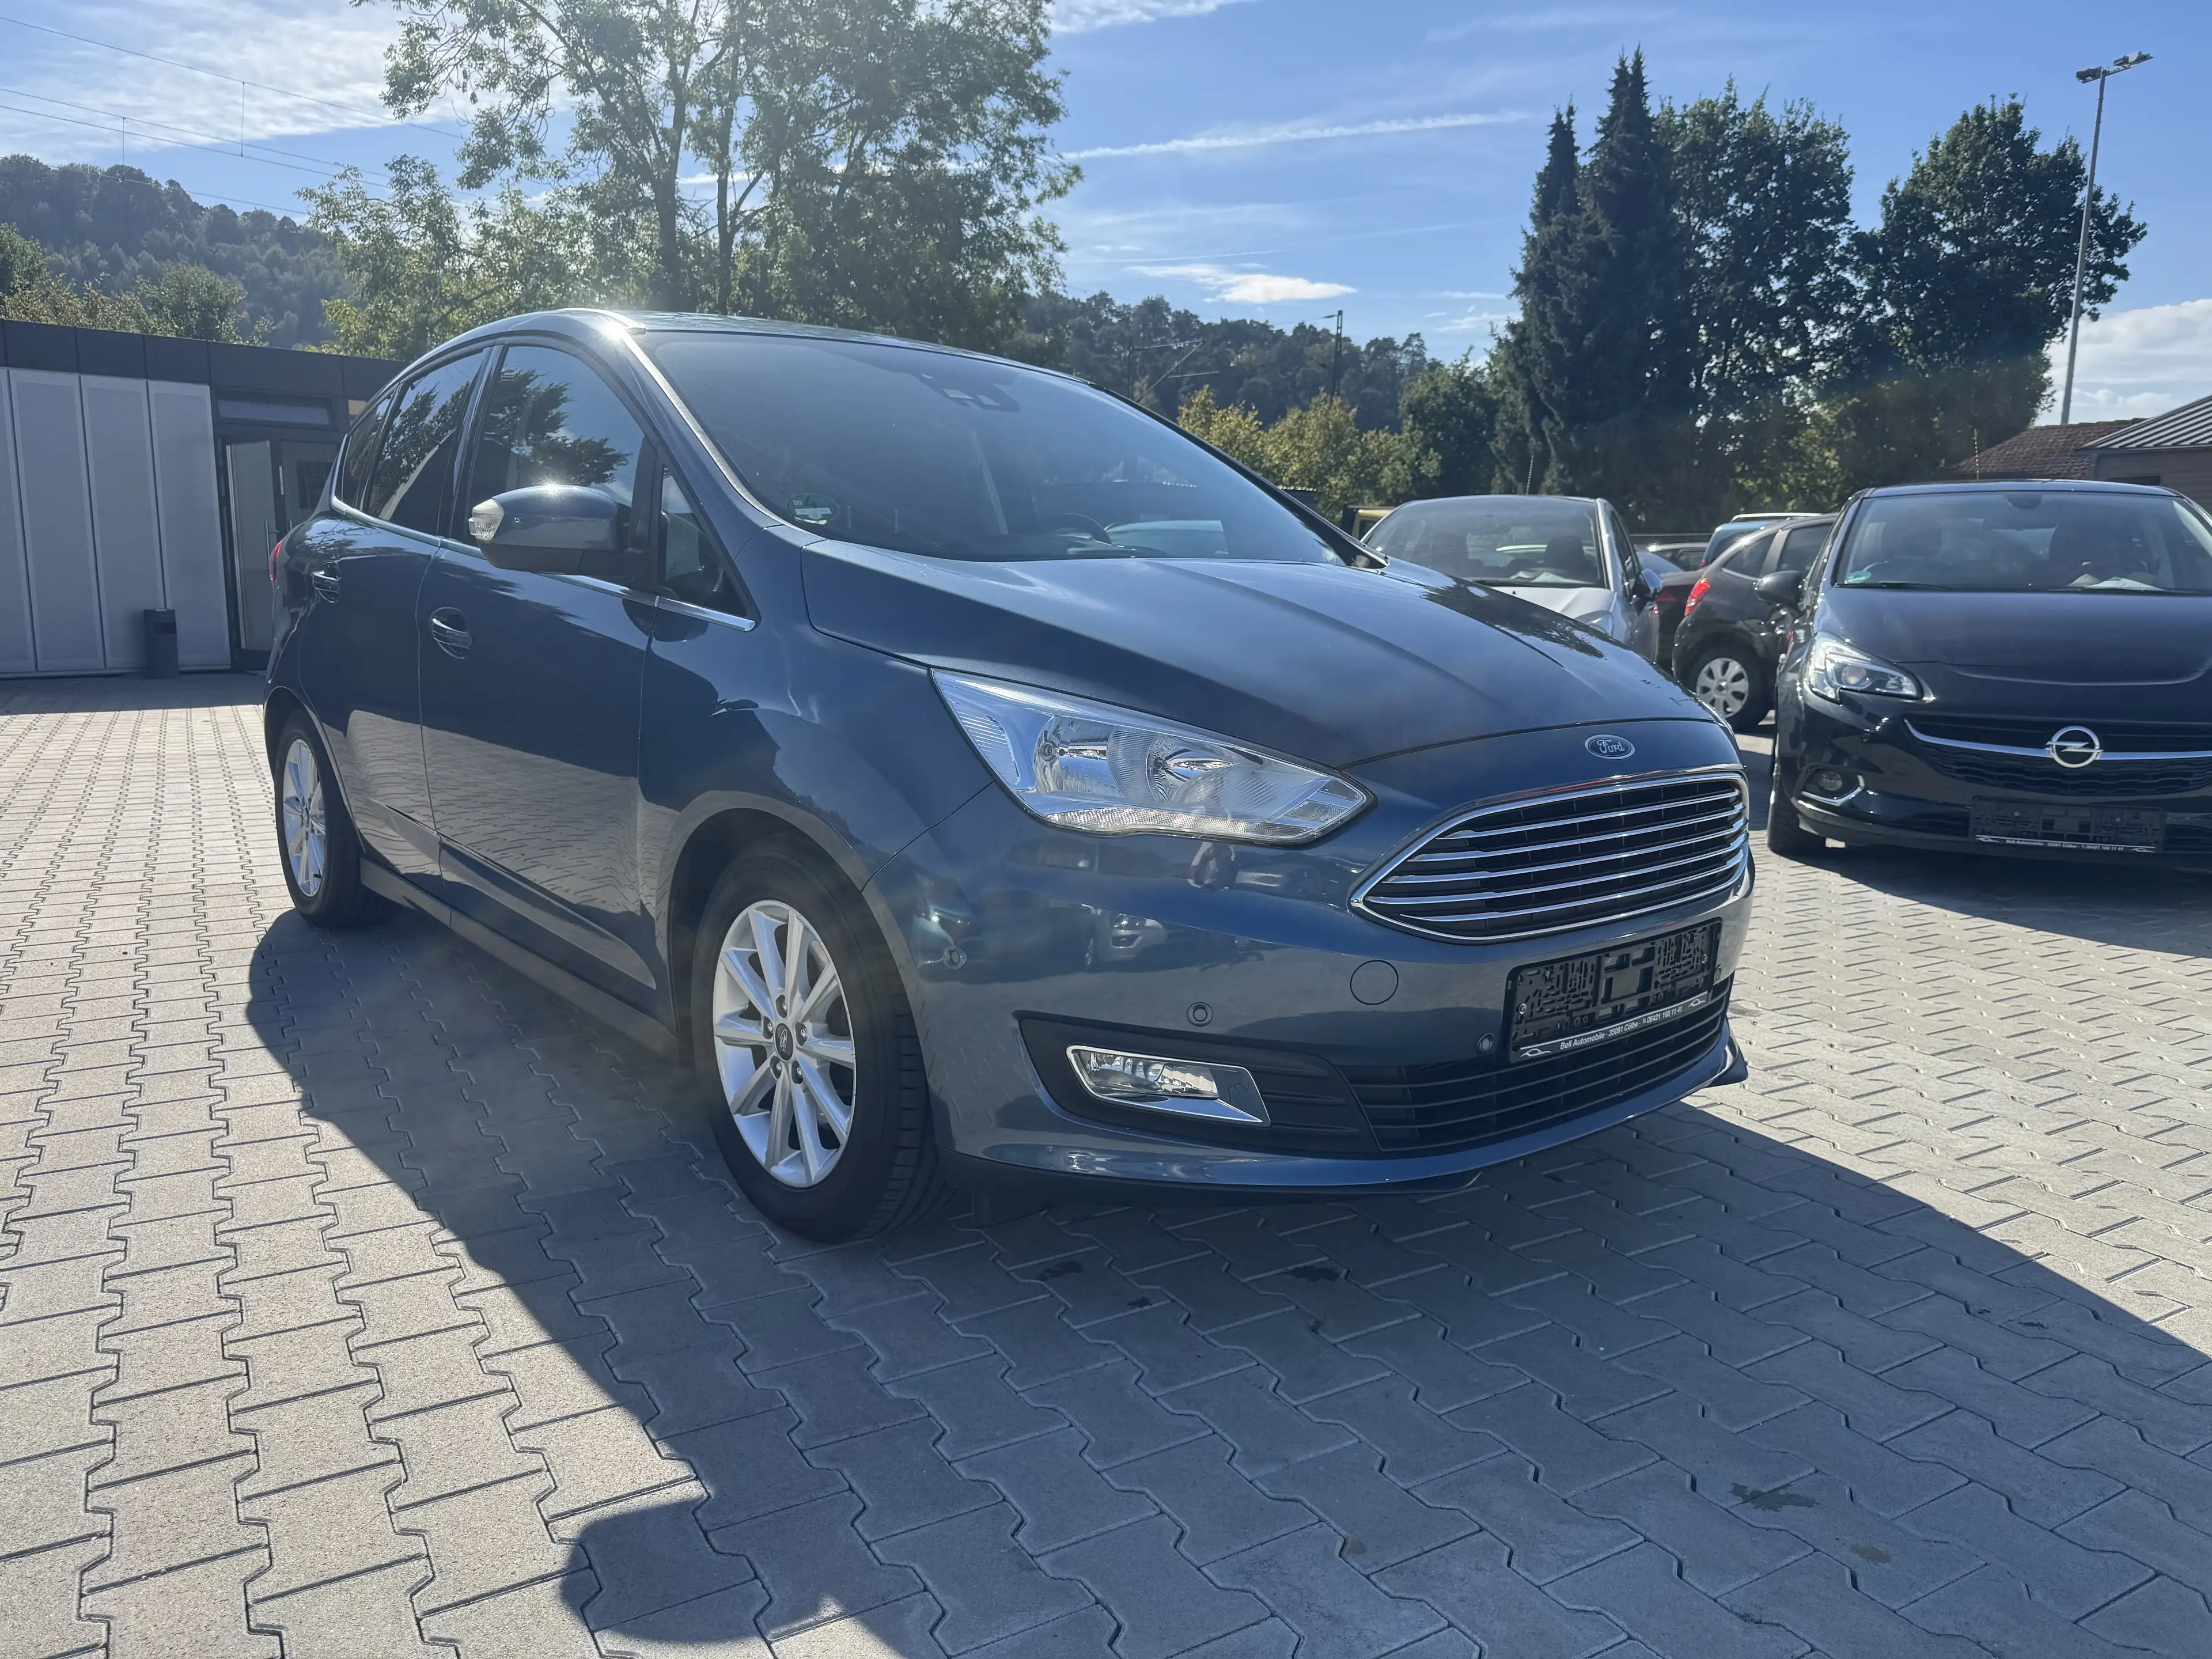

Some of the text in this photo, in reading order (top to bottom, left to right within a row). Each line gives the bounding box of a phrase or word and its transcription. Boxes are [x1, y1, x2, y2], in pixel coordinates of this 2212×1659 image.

[1597, 739, 1625, 754] Ford
[1560, 1041, 1571, 1050] Beli
[1573, 1033, 1604, 1046] Automobile
[1608, 1027, 1623, 1037] 35091
[1624, 1022, 1638, 1031] Cölbe
[1646, 1013, 1661, 1024] 06421
